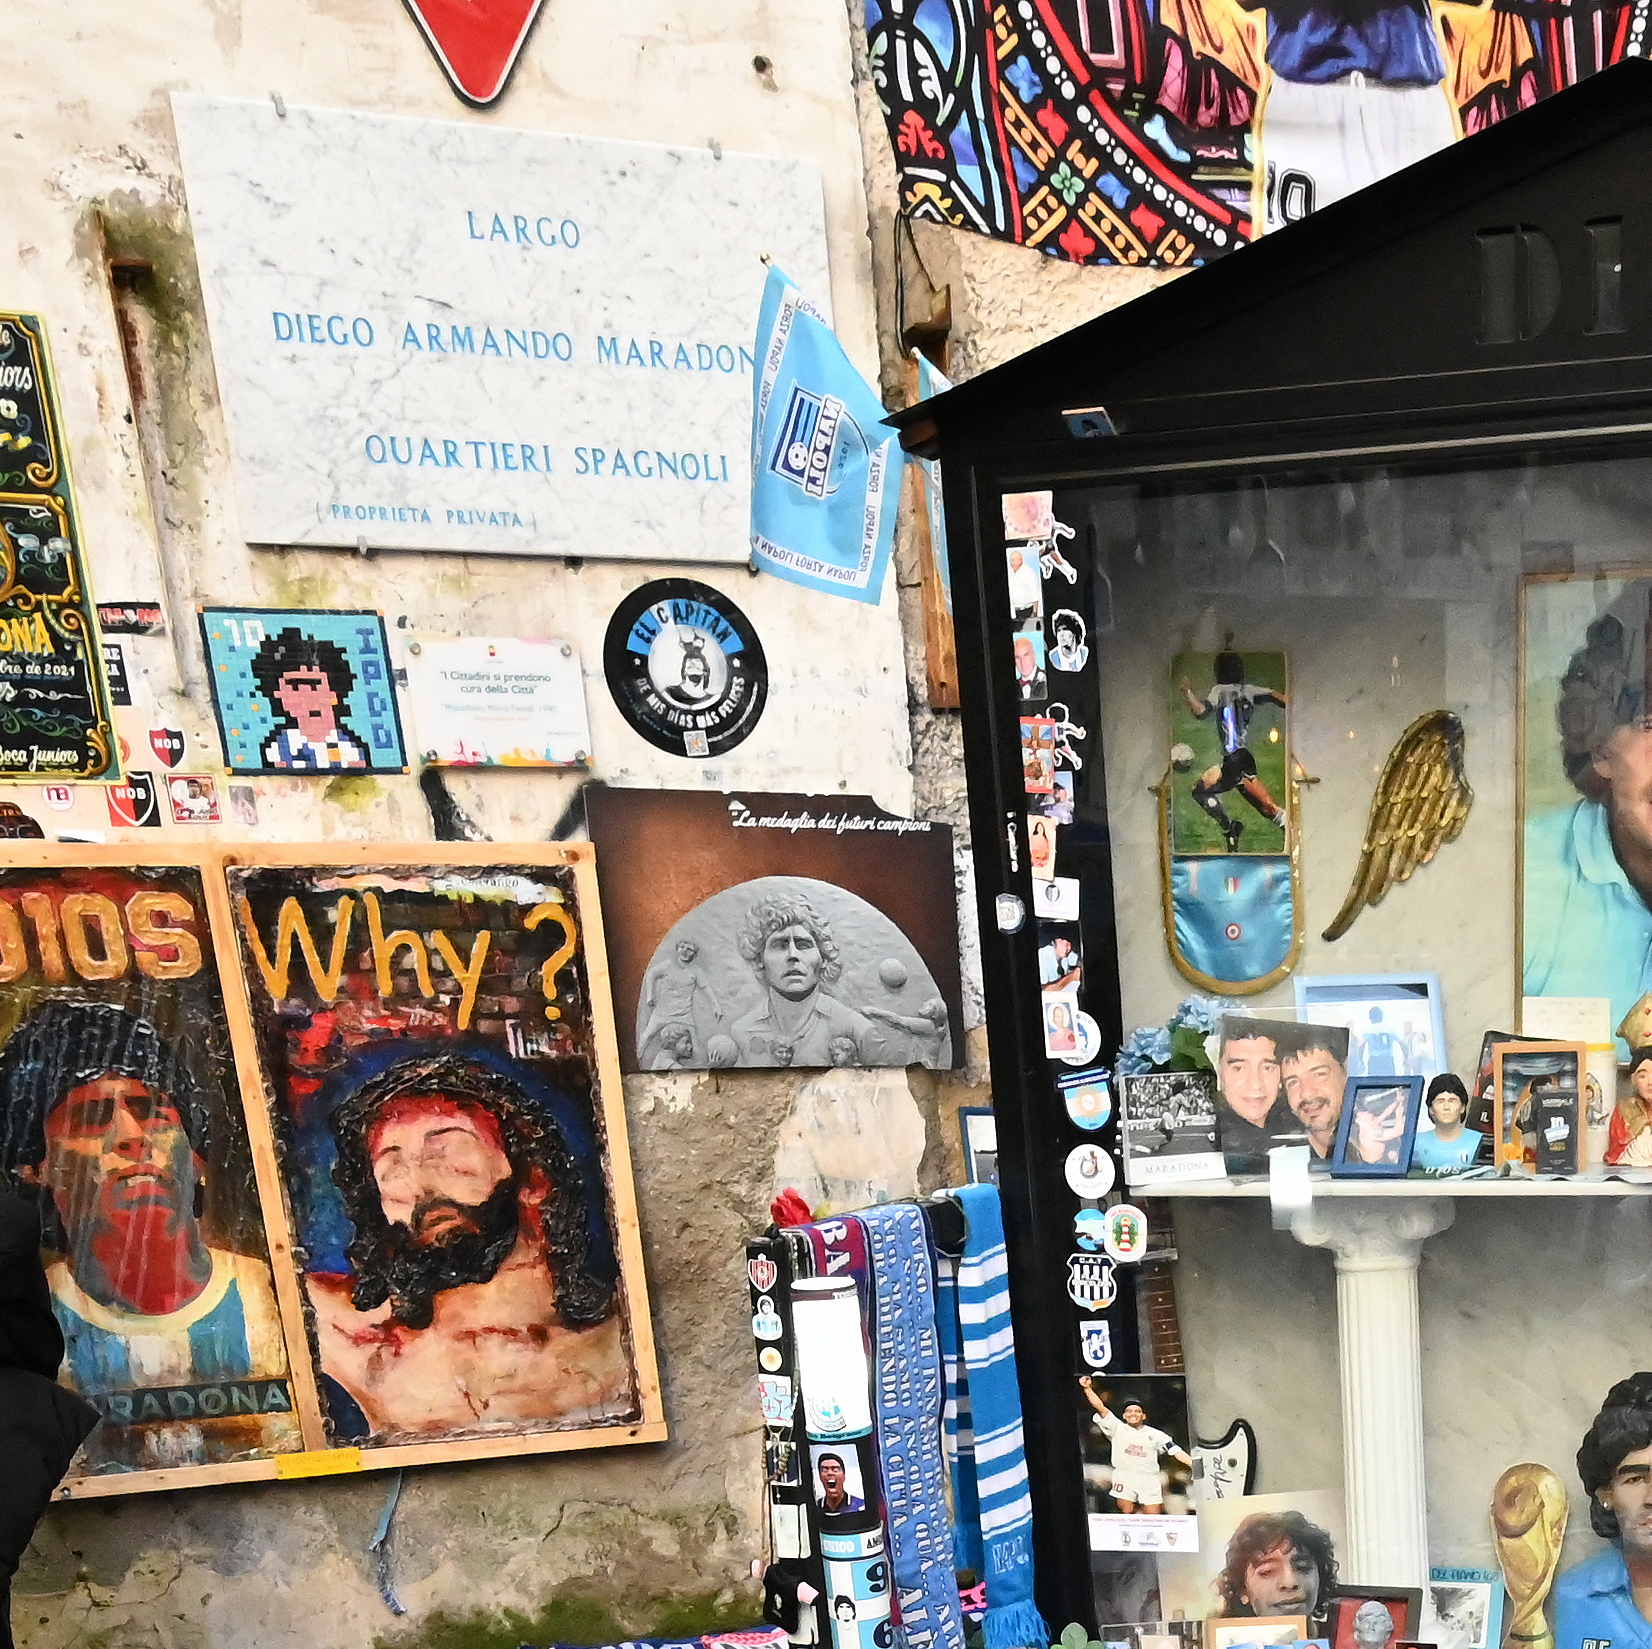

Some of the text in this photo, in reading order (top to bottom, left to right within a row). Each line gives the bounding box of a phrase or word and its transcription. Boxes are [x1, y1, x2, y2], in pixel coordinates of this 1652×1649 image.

[467, 210, 582, 250] LARGO
[272, 312, 374, 347] DIEGO
[402, 320, 573, 362] ARMANDO
[365, 434, 729, 483] QUARTIERI SPAGNOLI
[25, 661, 42, 675] de
[30, 744, 79, 770] Juniors
[154, 737, 181, 750] NOB
[115, 785, 147, 799] NOB
[758, 812, 815, 833] medaglia
[818, 815, 835, 830] dei
[243, 890, 488, 1031] Why
[102, 1383, 289, 1427] RADONA
[883, 1416, 902, 1448] LA
[866, 1562, 887, 1592] 9
[873, 1622, 893, 1649] 6
